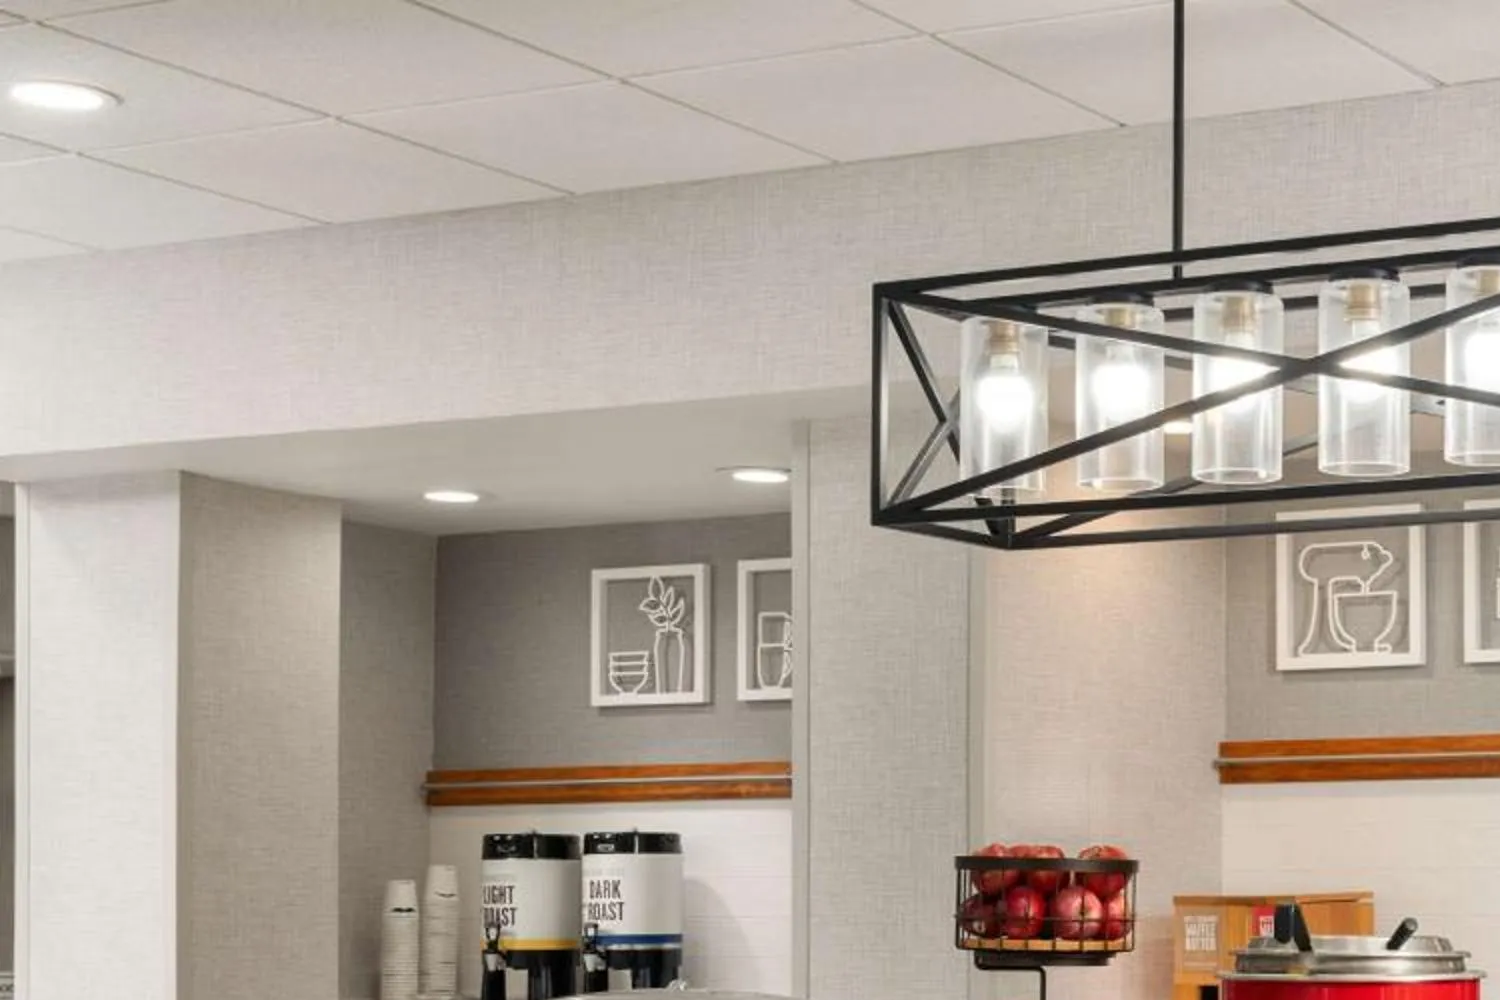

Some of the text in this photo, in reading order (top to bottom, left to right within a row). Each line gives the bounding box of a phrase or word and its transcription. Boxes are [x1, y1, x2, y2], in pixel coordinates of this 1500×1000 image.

[483, 885, 515, 905] LIGHT
[589, 879, 622, 900] DARK
[587, 901, 625, 921] ROAST
